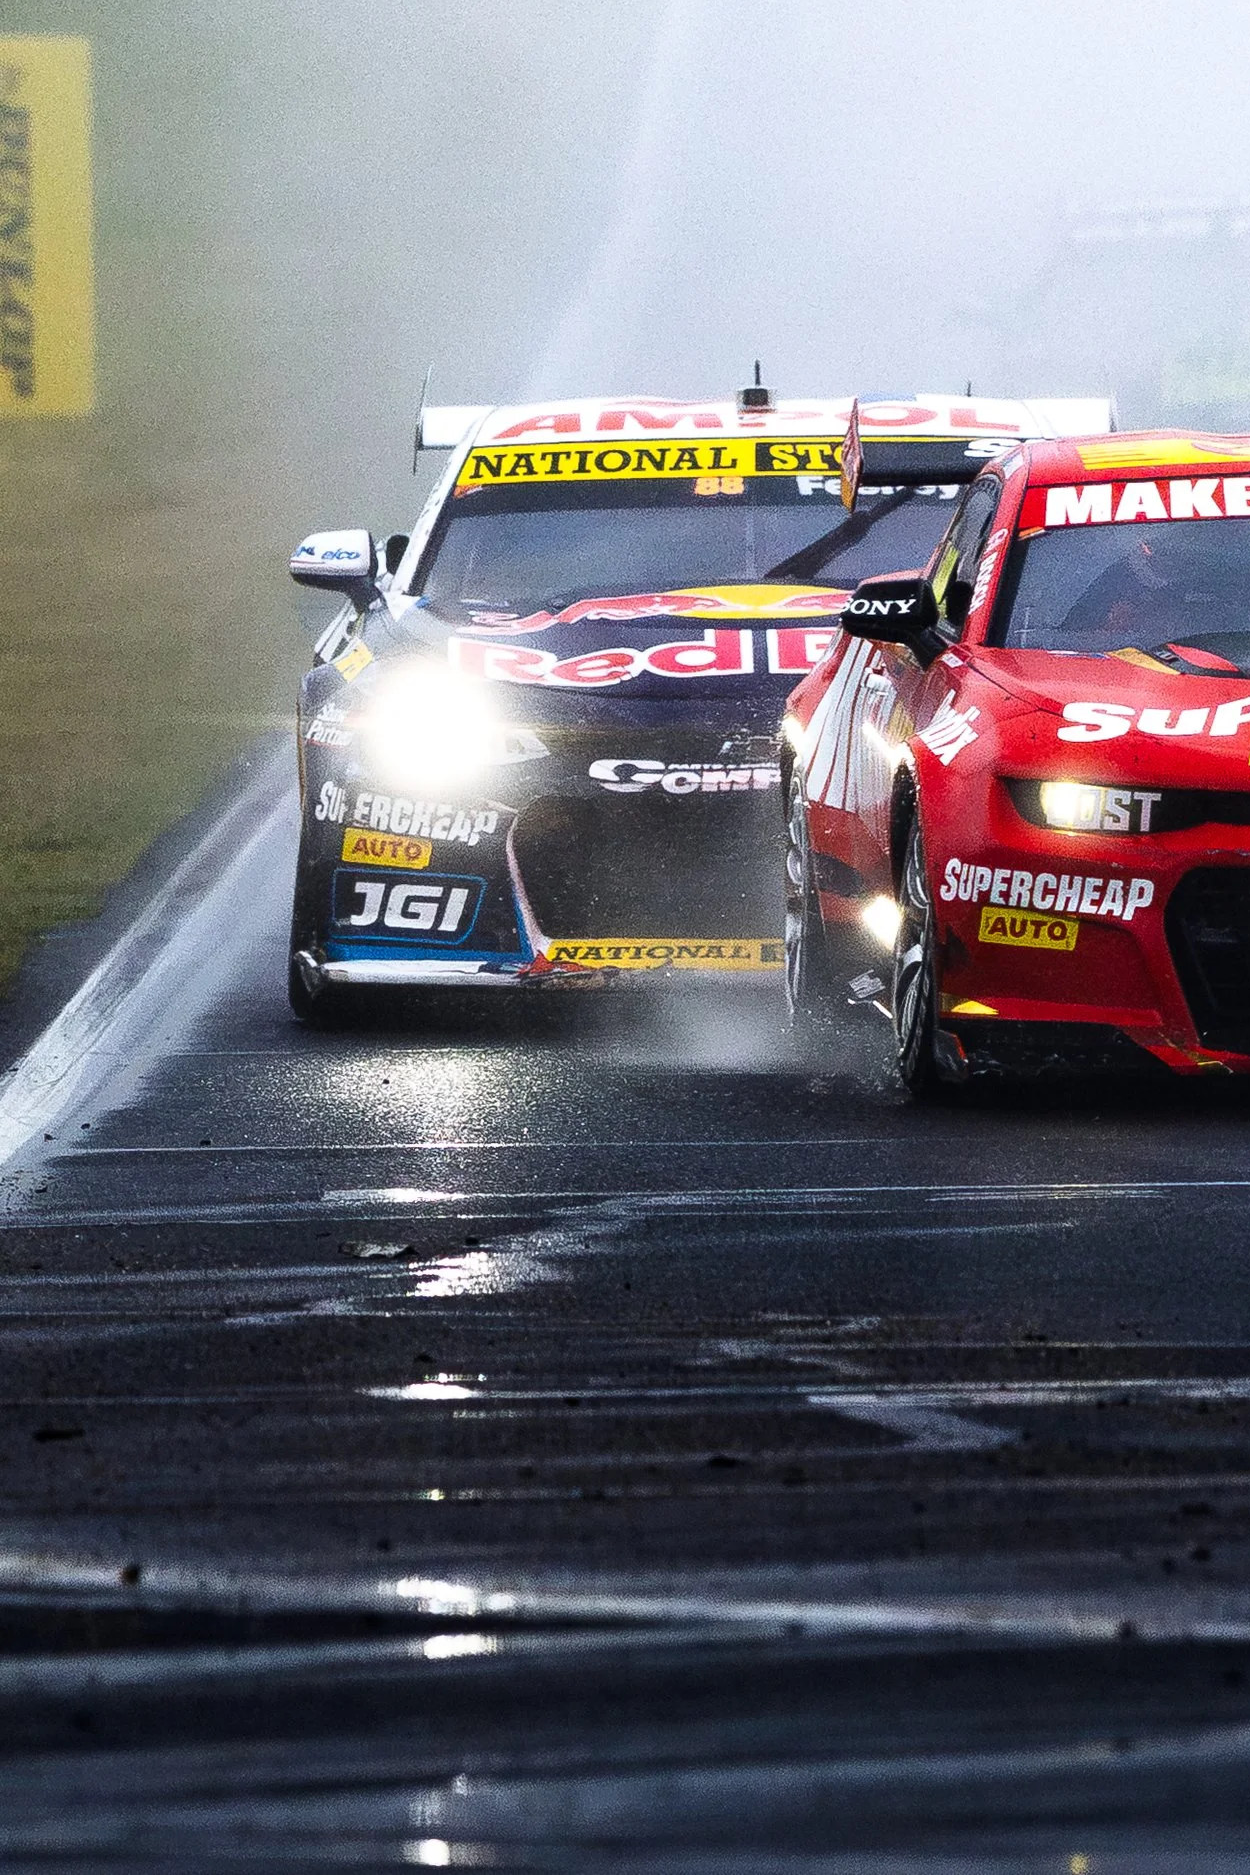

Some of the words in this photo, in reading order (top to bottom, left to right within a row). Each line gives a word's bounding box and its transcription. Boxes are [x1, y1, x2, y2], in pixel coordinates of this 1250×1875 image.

[468, 446, 738, 479] NATIONAL
[694, 476, 744, 496] 88
[447, 628, 755, 688] Red
[351, 837, 423, 861] AUTO
[939, 858, 1155, 921] SUPERCHEAP
[350, 882, 470, 932] JGI
[987, 916, 1069, 942] AUTO
[553, 944, 751, 961] NATIONAL
